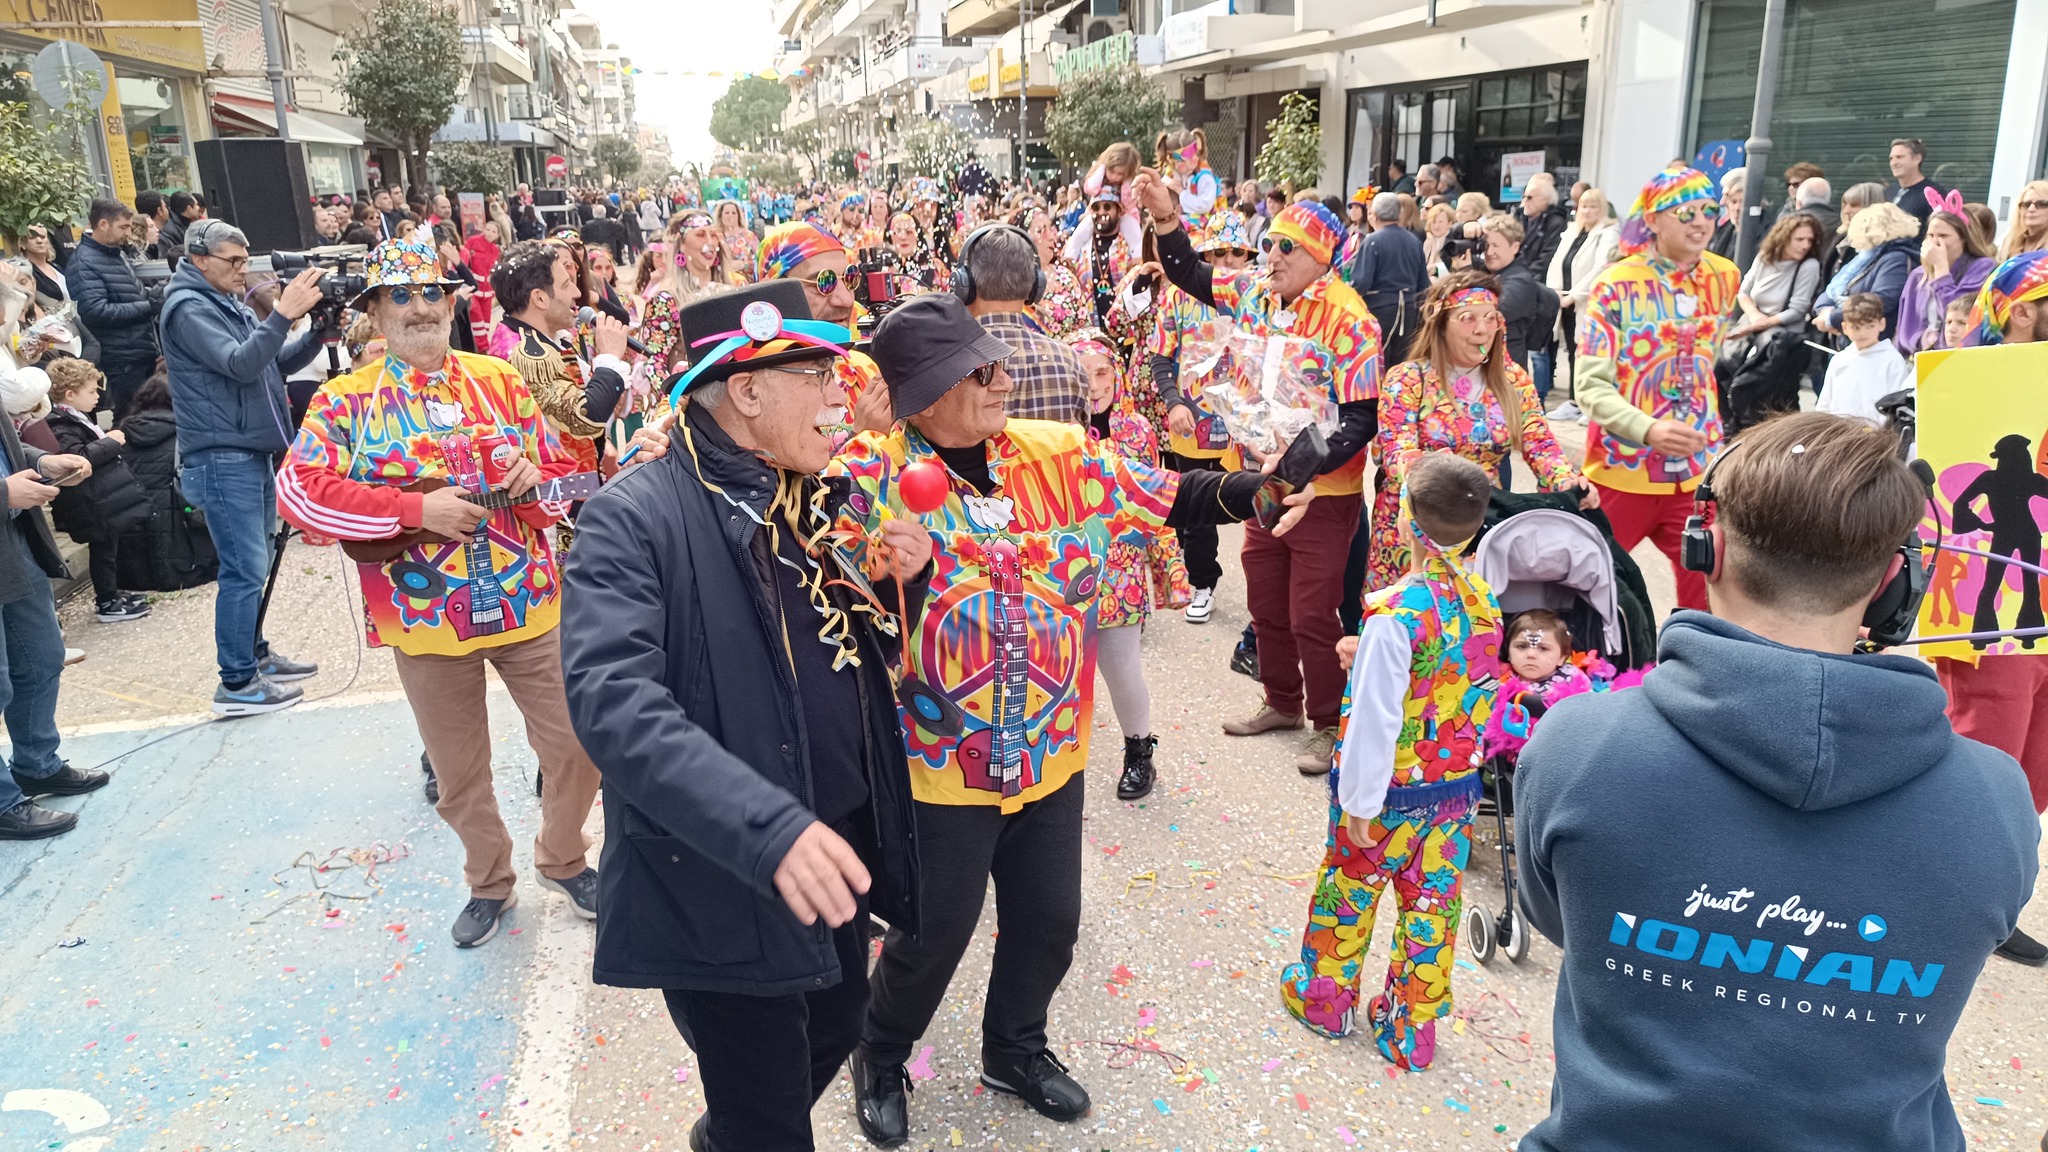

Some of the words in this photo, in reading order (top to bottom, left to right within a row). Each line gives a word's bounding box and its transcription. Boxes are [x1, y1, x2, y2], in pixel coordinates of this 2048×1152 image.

[1002, 448, 1097, 533] LOVE
[940, 588, 1072, 687] MUSIC
[1684, 883, 1754, 917] just
[1605, 958, 1693, 992] GREEK
[1715, 985, 1876, 1022] REGIONAL
[1897, 1012, 1926, 1024] TV
[1608, 911, 1945, 998] IONIAN
